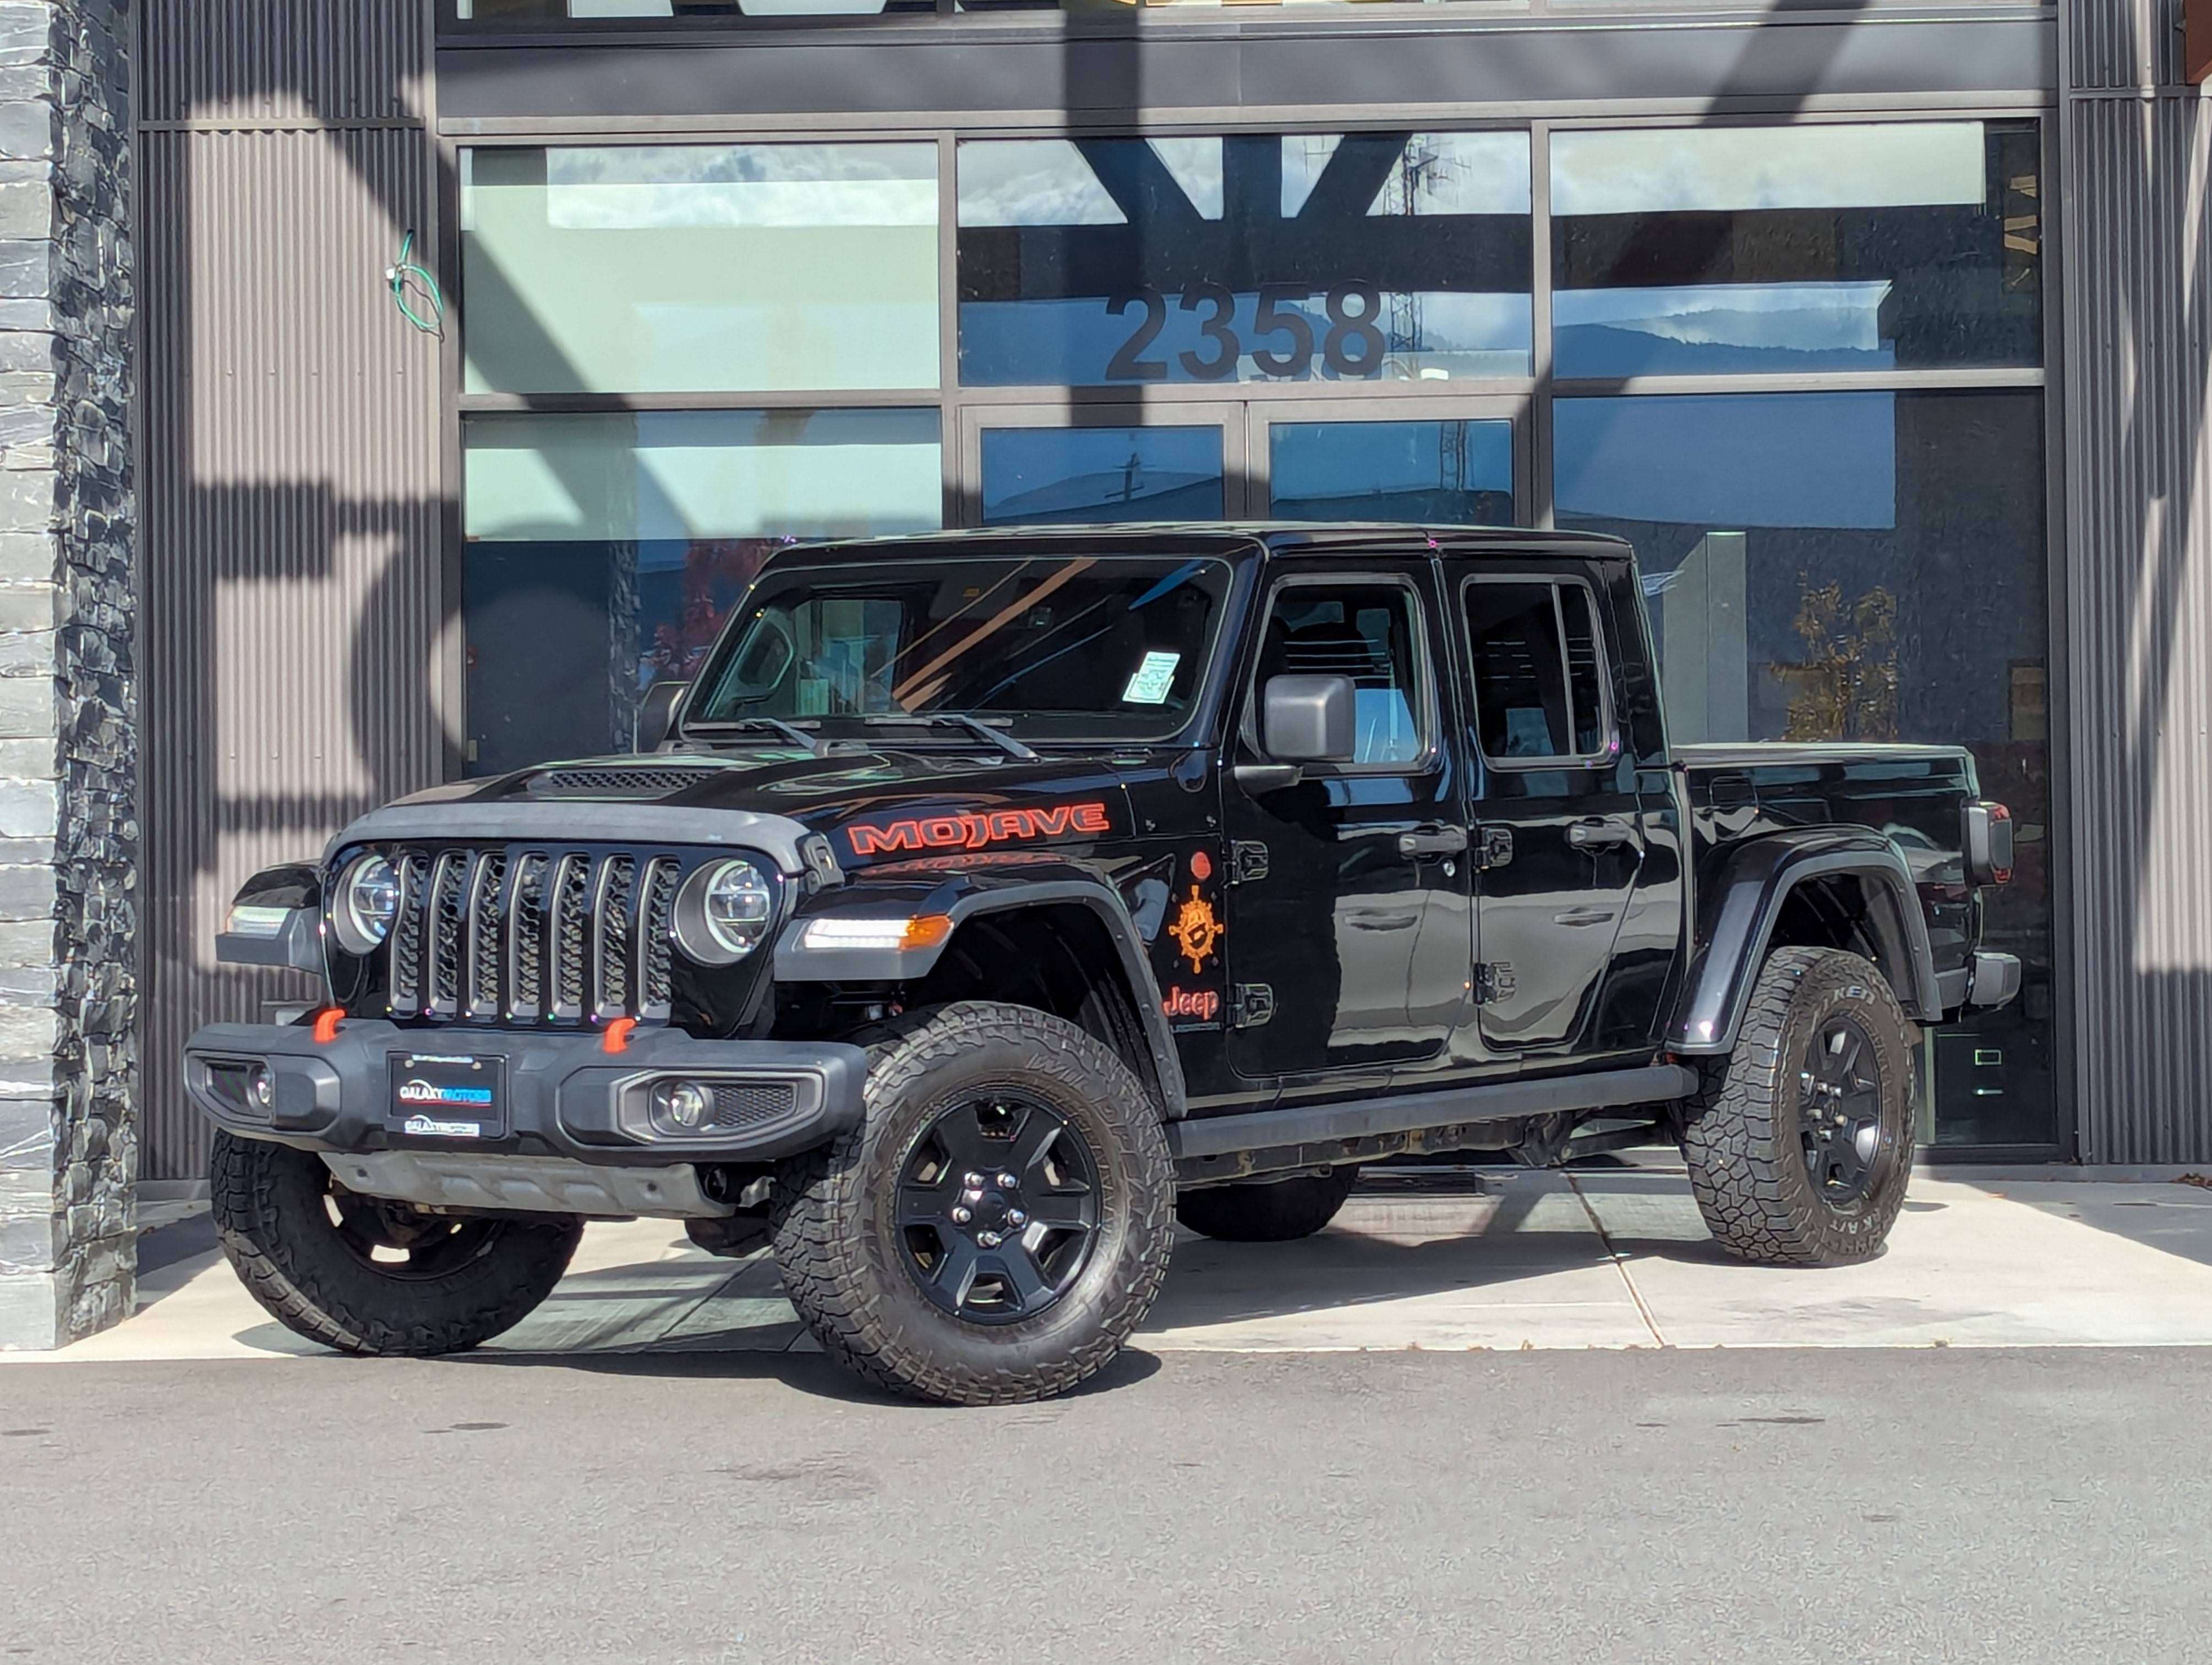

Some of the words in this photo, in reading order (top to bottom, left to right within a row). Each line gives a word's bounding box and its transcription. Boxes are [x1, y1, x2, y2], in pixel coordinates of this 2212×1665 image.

[1105, 280, 1385, 380] 2358
[848, 803, 1110, 854] MOJAVE
[1163, 986, 1219, 1020] Jeep
